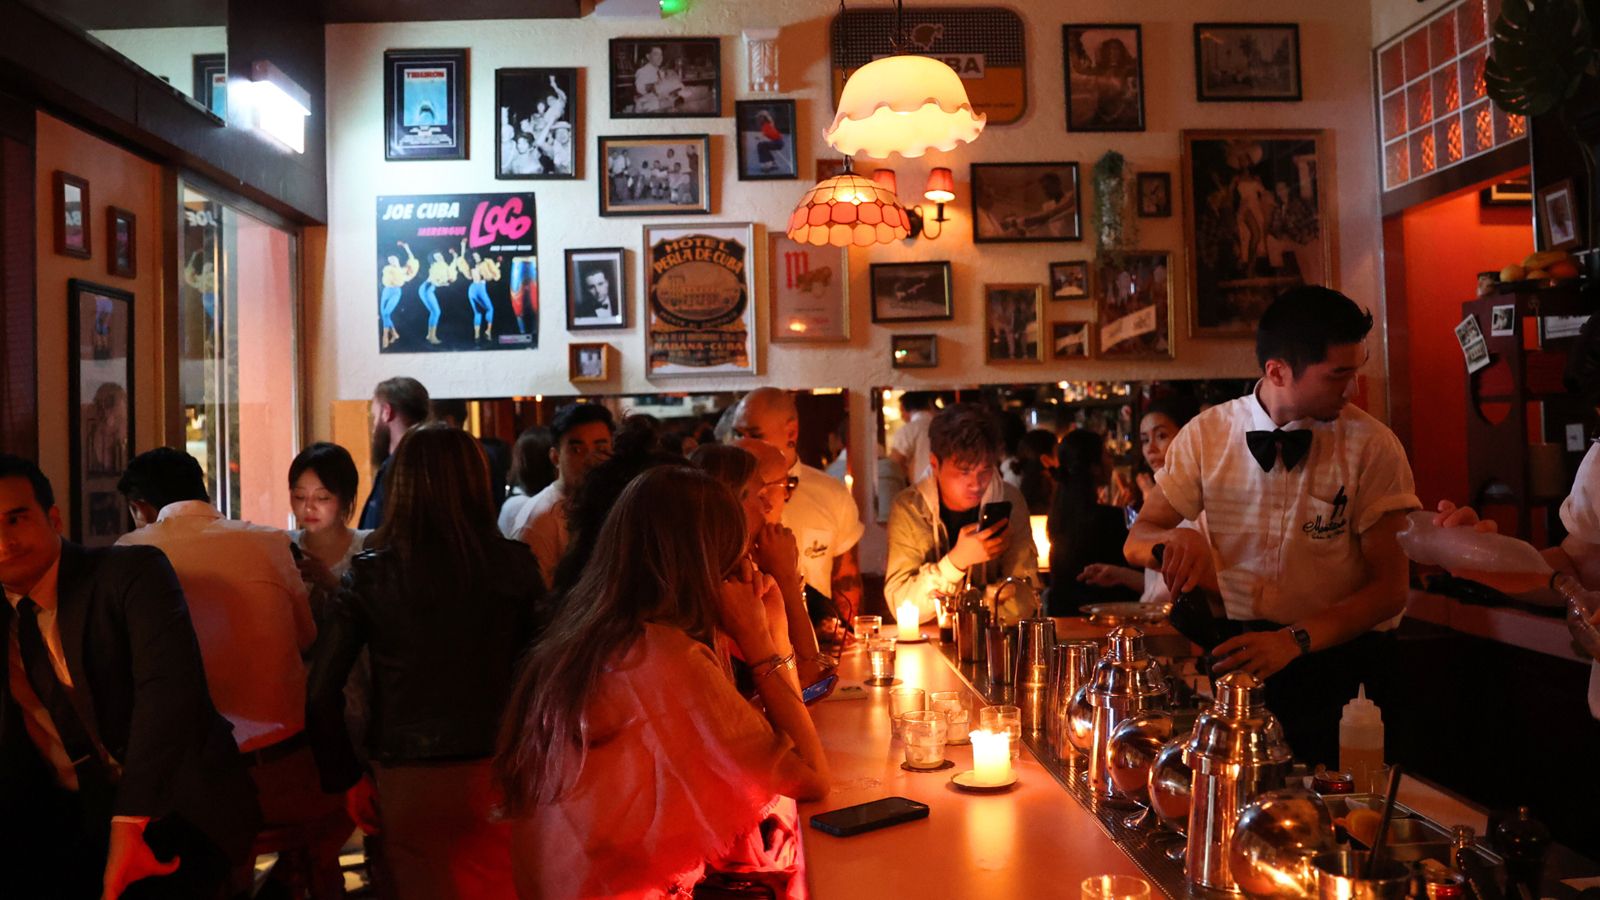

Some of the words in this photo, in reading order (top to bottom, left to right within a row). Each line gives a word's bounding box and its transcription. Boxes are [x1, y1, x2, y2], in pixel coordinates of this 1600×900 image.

[383, 203, 414, 220] JOE
[417, 202, 460, 218] CUBA
[469, 197, 532, 248] LOCO
[665, 239, 727, 253] HOTEL
[654, 249, 692, 273] PERLA
[695, 248, 712, 260] DE
[713, 251, 742, 273] CUBA
